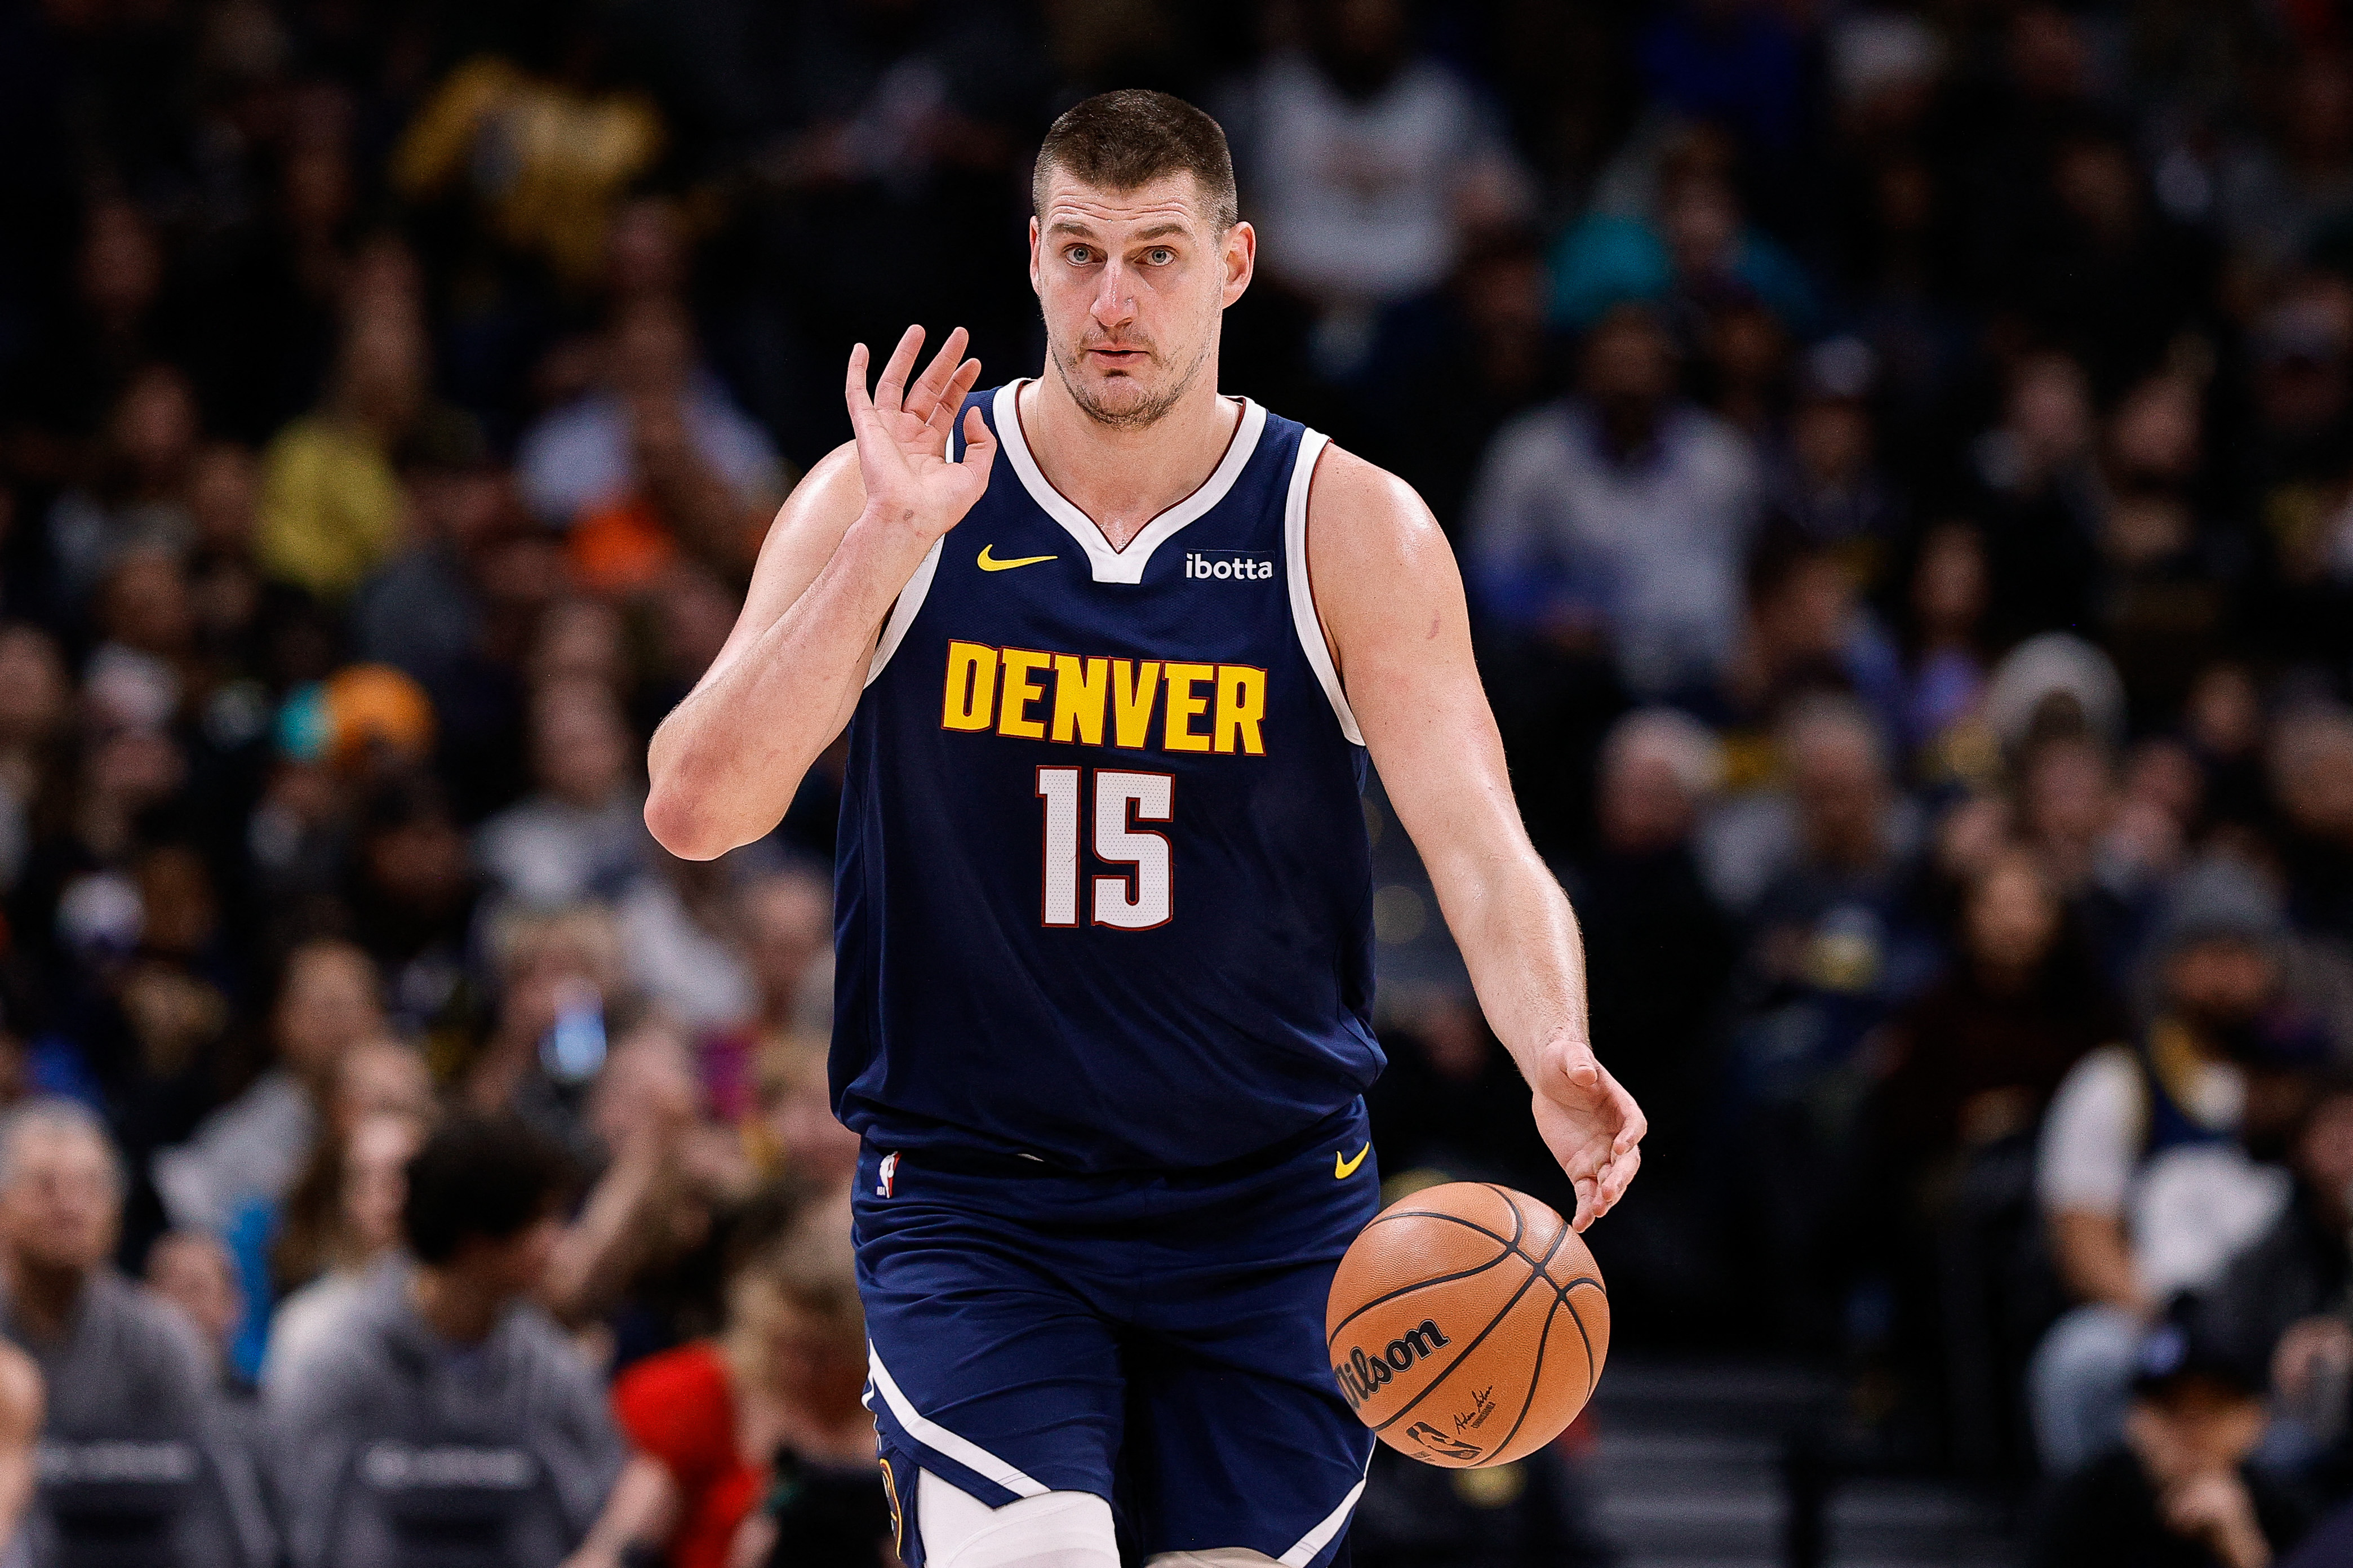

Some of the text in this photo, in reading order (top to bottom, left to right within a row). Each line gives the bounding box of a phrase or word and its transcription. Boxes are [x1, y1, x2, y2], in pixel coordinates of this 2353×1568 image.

[1186, 553, 1272, 580] ibotta
[940, 639, 1268, 756] DENVER
[1035, 765, 1175, 931] 15
